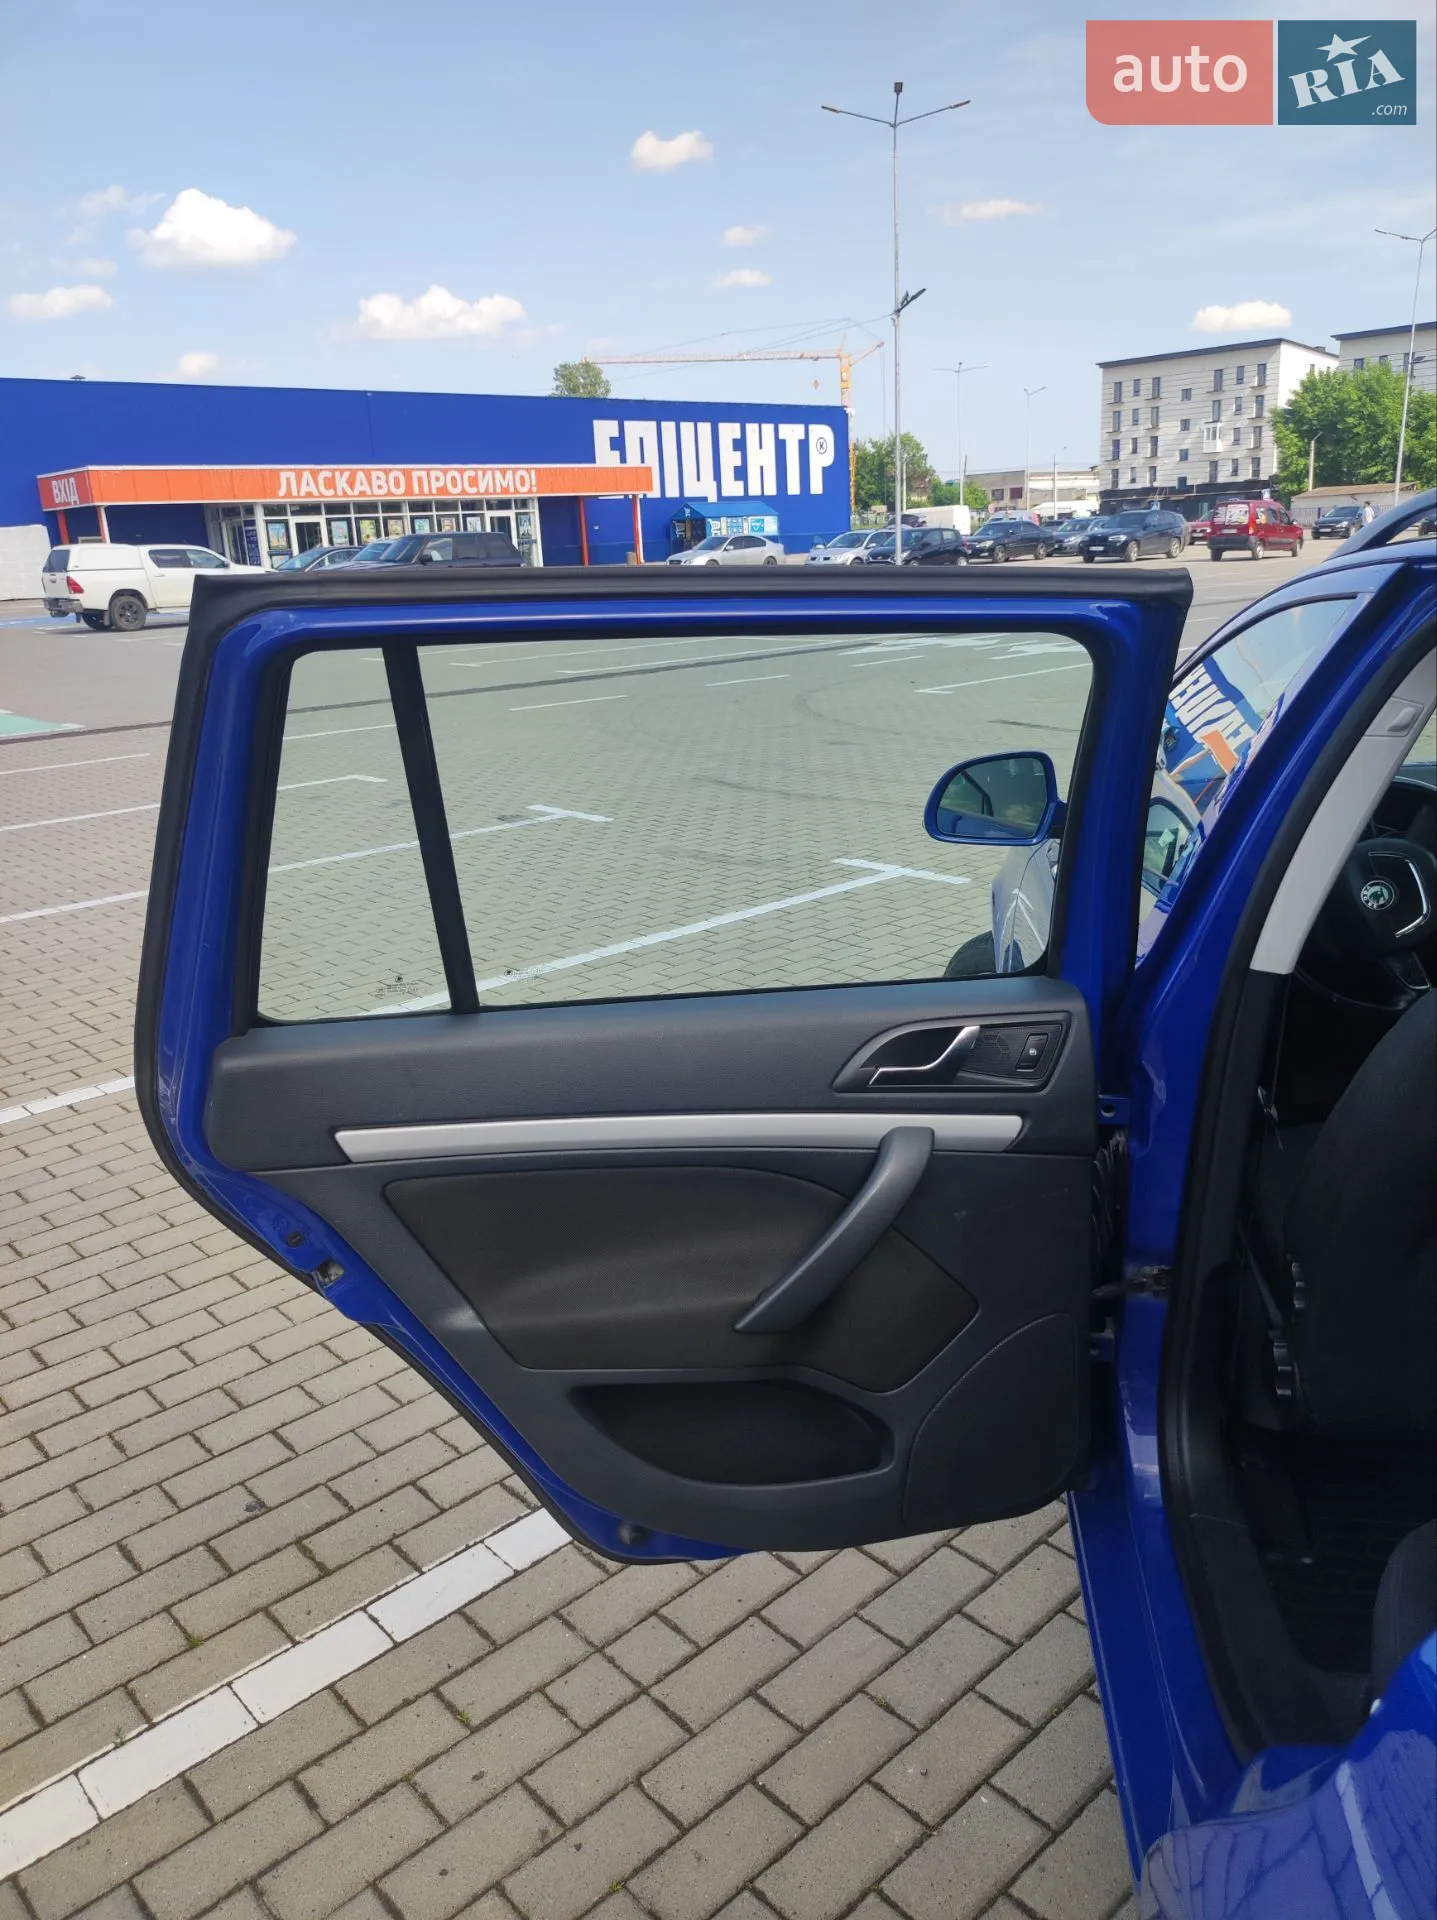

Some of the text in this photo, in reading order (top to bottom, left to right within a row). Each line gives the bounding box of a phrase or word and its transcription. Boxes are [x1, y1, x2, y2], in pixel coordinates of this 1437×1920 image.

[593, 419, 836, 503] ЕПІЦЕНТР
[51, 477, 80, 506] ВХІД
[278, 469, 537, 497] ЛАСКАВО ПРОСИМО!
